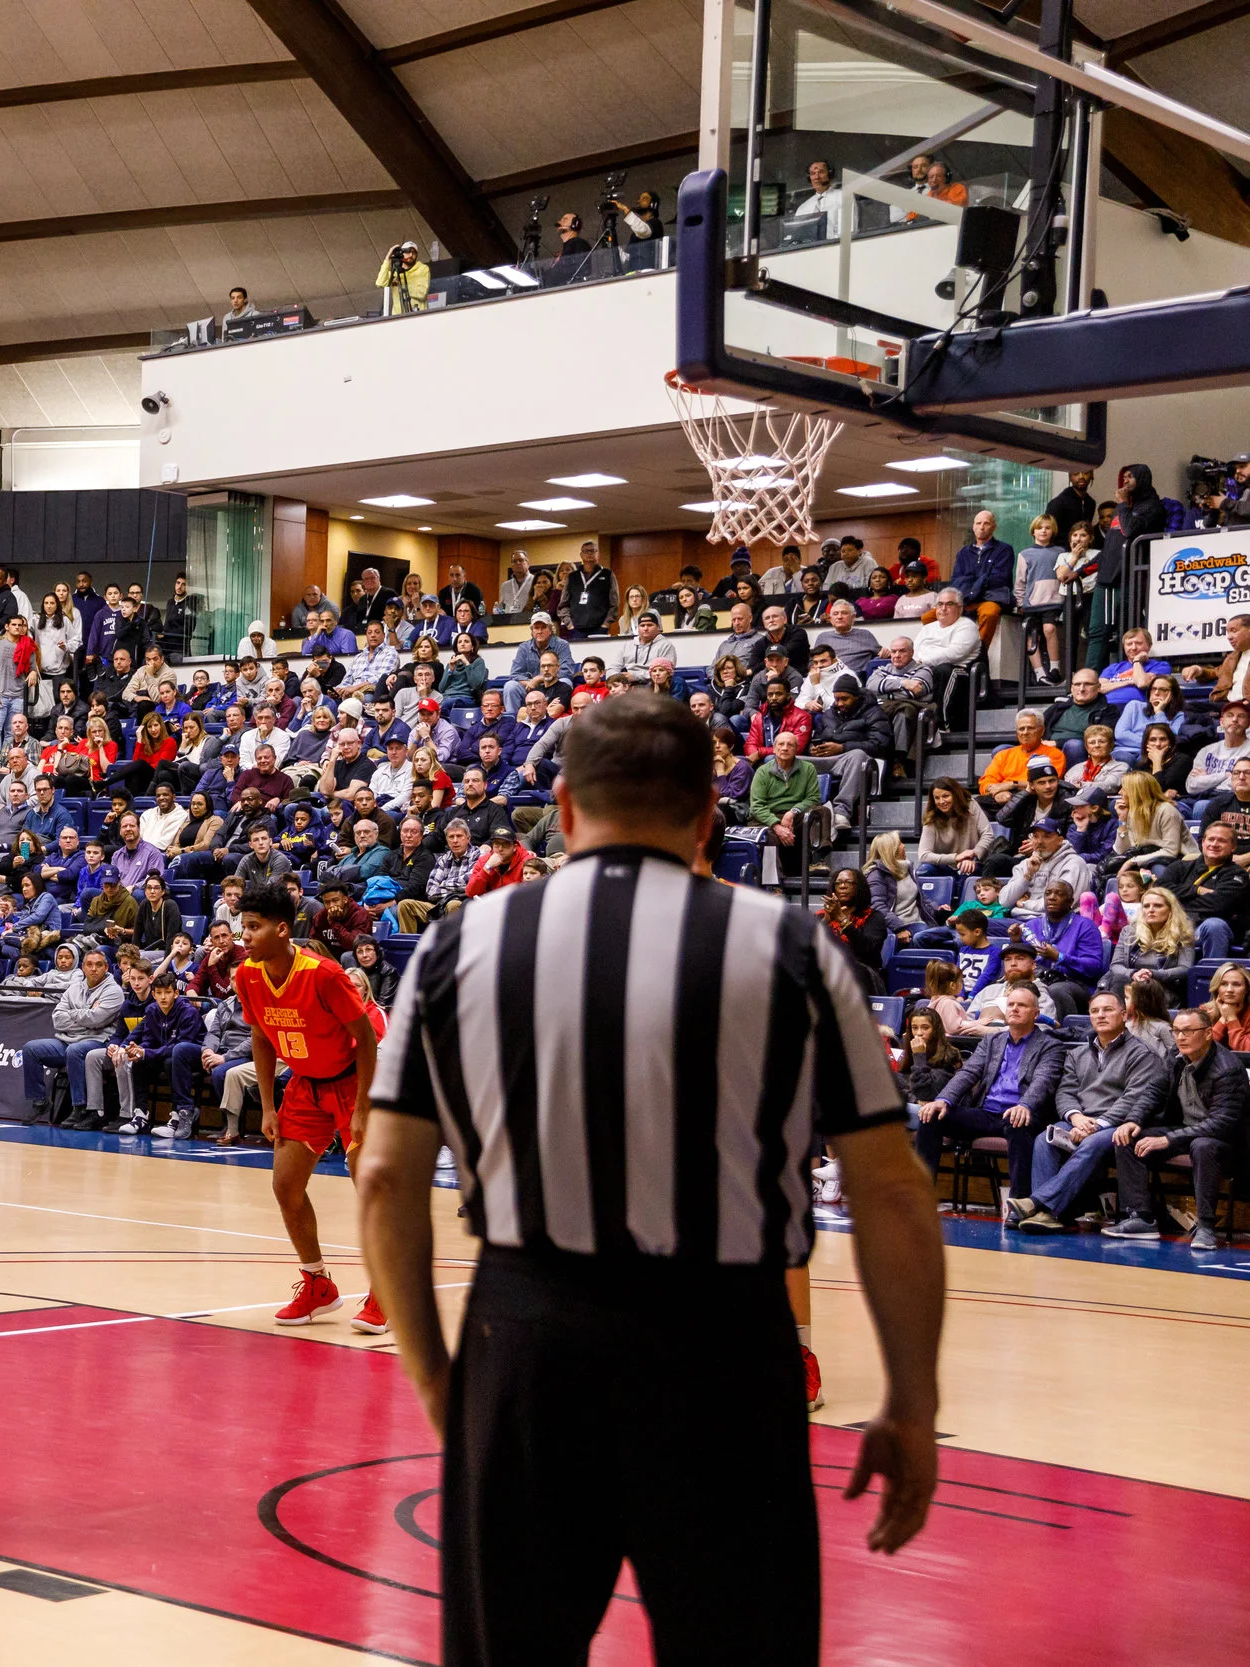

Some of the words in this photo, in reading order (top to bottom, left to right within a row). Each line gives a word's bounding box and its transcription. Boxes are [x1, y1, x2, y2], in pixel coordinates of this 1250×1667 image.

[1175, 553, 1247, 571] Boardwalk
[1159, 572, 1231, 595] Hoop
[961, 957, 984, 979] 25
[264, 1007, 299, 1018] BERGEN
[264, 1016, 306, 1027] CATHOLIC
[277, 1031, 309, 1058] 13
